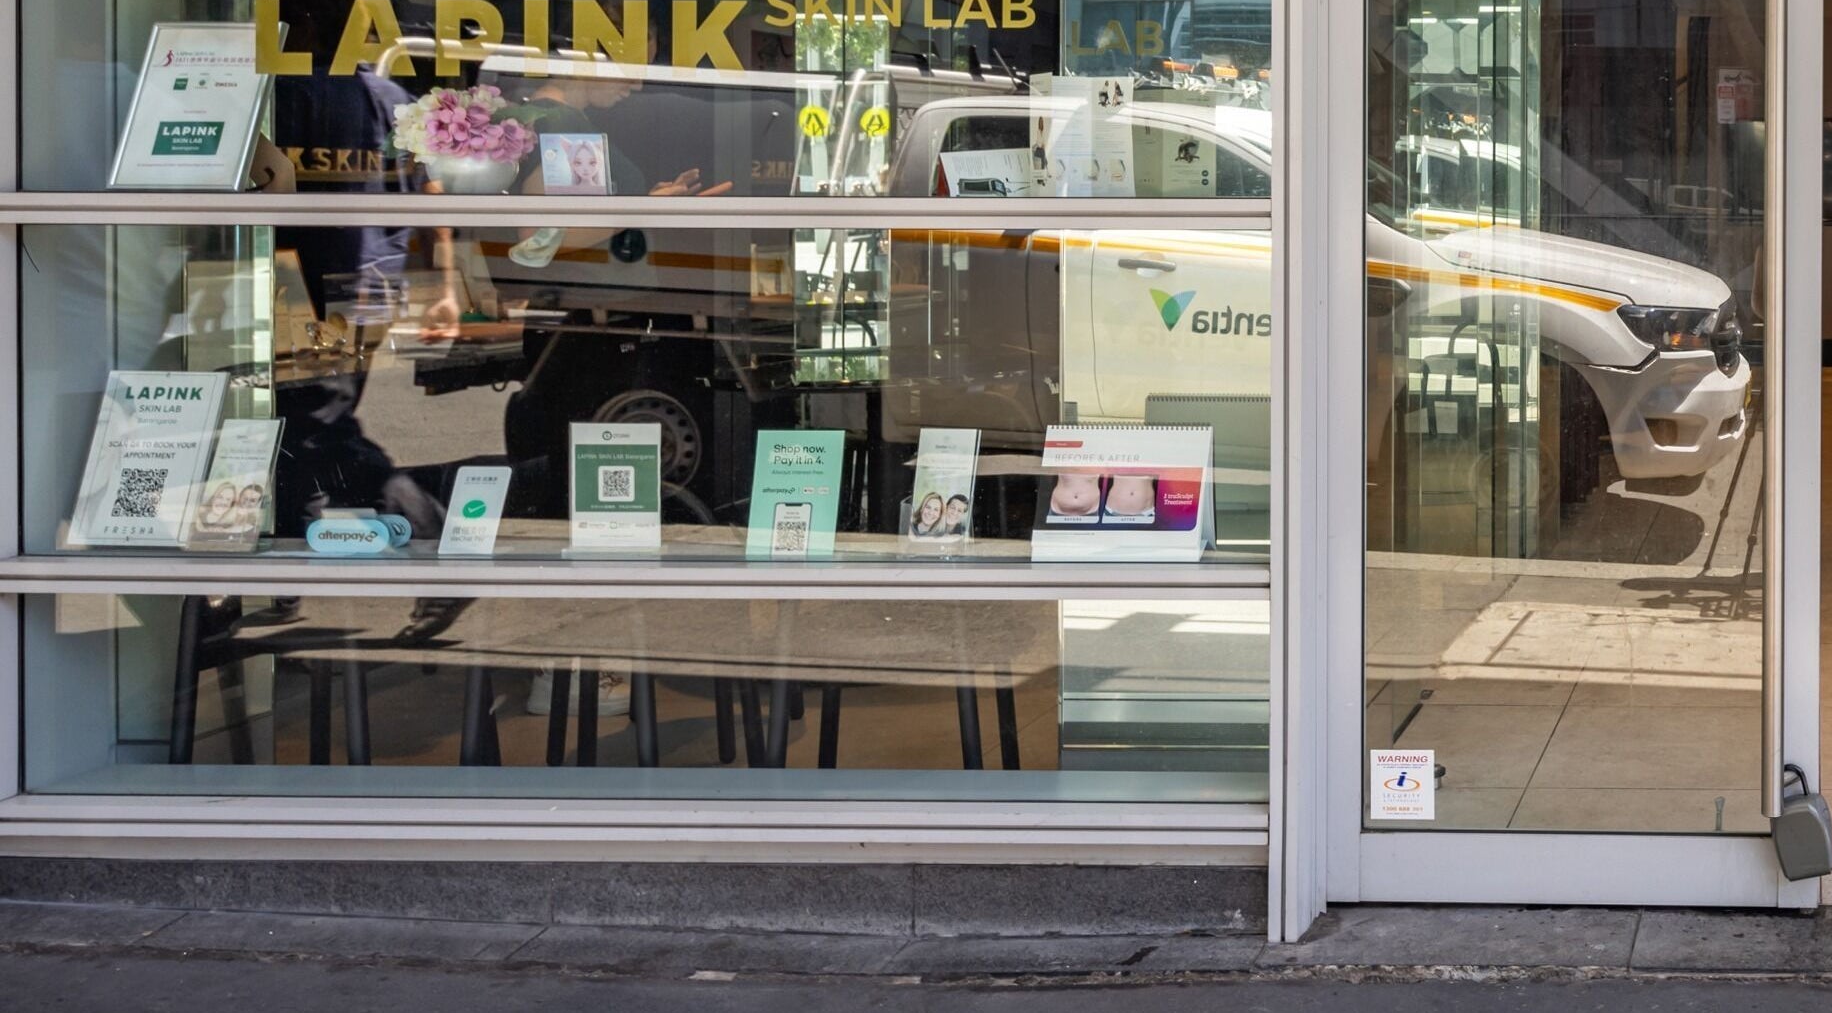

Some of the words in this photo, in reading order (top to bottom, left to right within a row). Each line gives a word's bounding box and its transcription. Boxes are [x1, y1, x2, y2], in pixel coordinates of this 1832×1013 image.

[1071, 20, 1165, 56] LAB
[162, 126, 217, 136] LAPINK
[311, 147, 383, 173] SKIN
[125, 386, 203, 400] LAPINK
[139, 405, 161, 413] SKIN
[163, 405, 182, 414] LAB
[774, 444, 801, 456] Shop
[803, 445, 826, 454] now.
[123, 452, 176, 460] APPOINTMENT
[1054, 453, 1096, 462] BEFORE
[1108, 454, 1141, 463] AFTER
[774, 456, 794, 467] Pay
[796, 456, 802, 465] it
[804, 456, 813, 465] in
[104, 526, 155, 535] FRESHA
[318, 530, 365, 542] afterpay
[1377, 755, 1429, 763] WARNING
